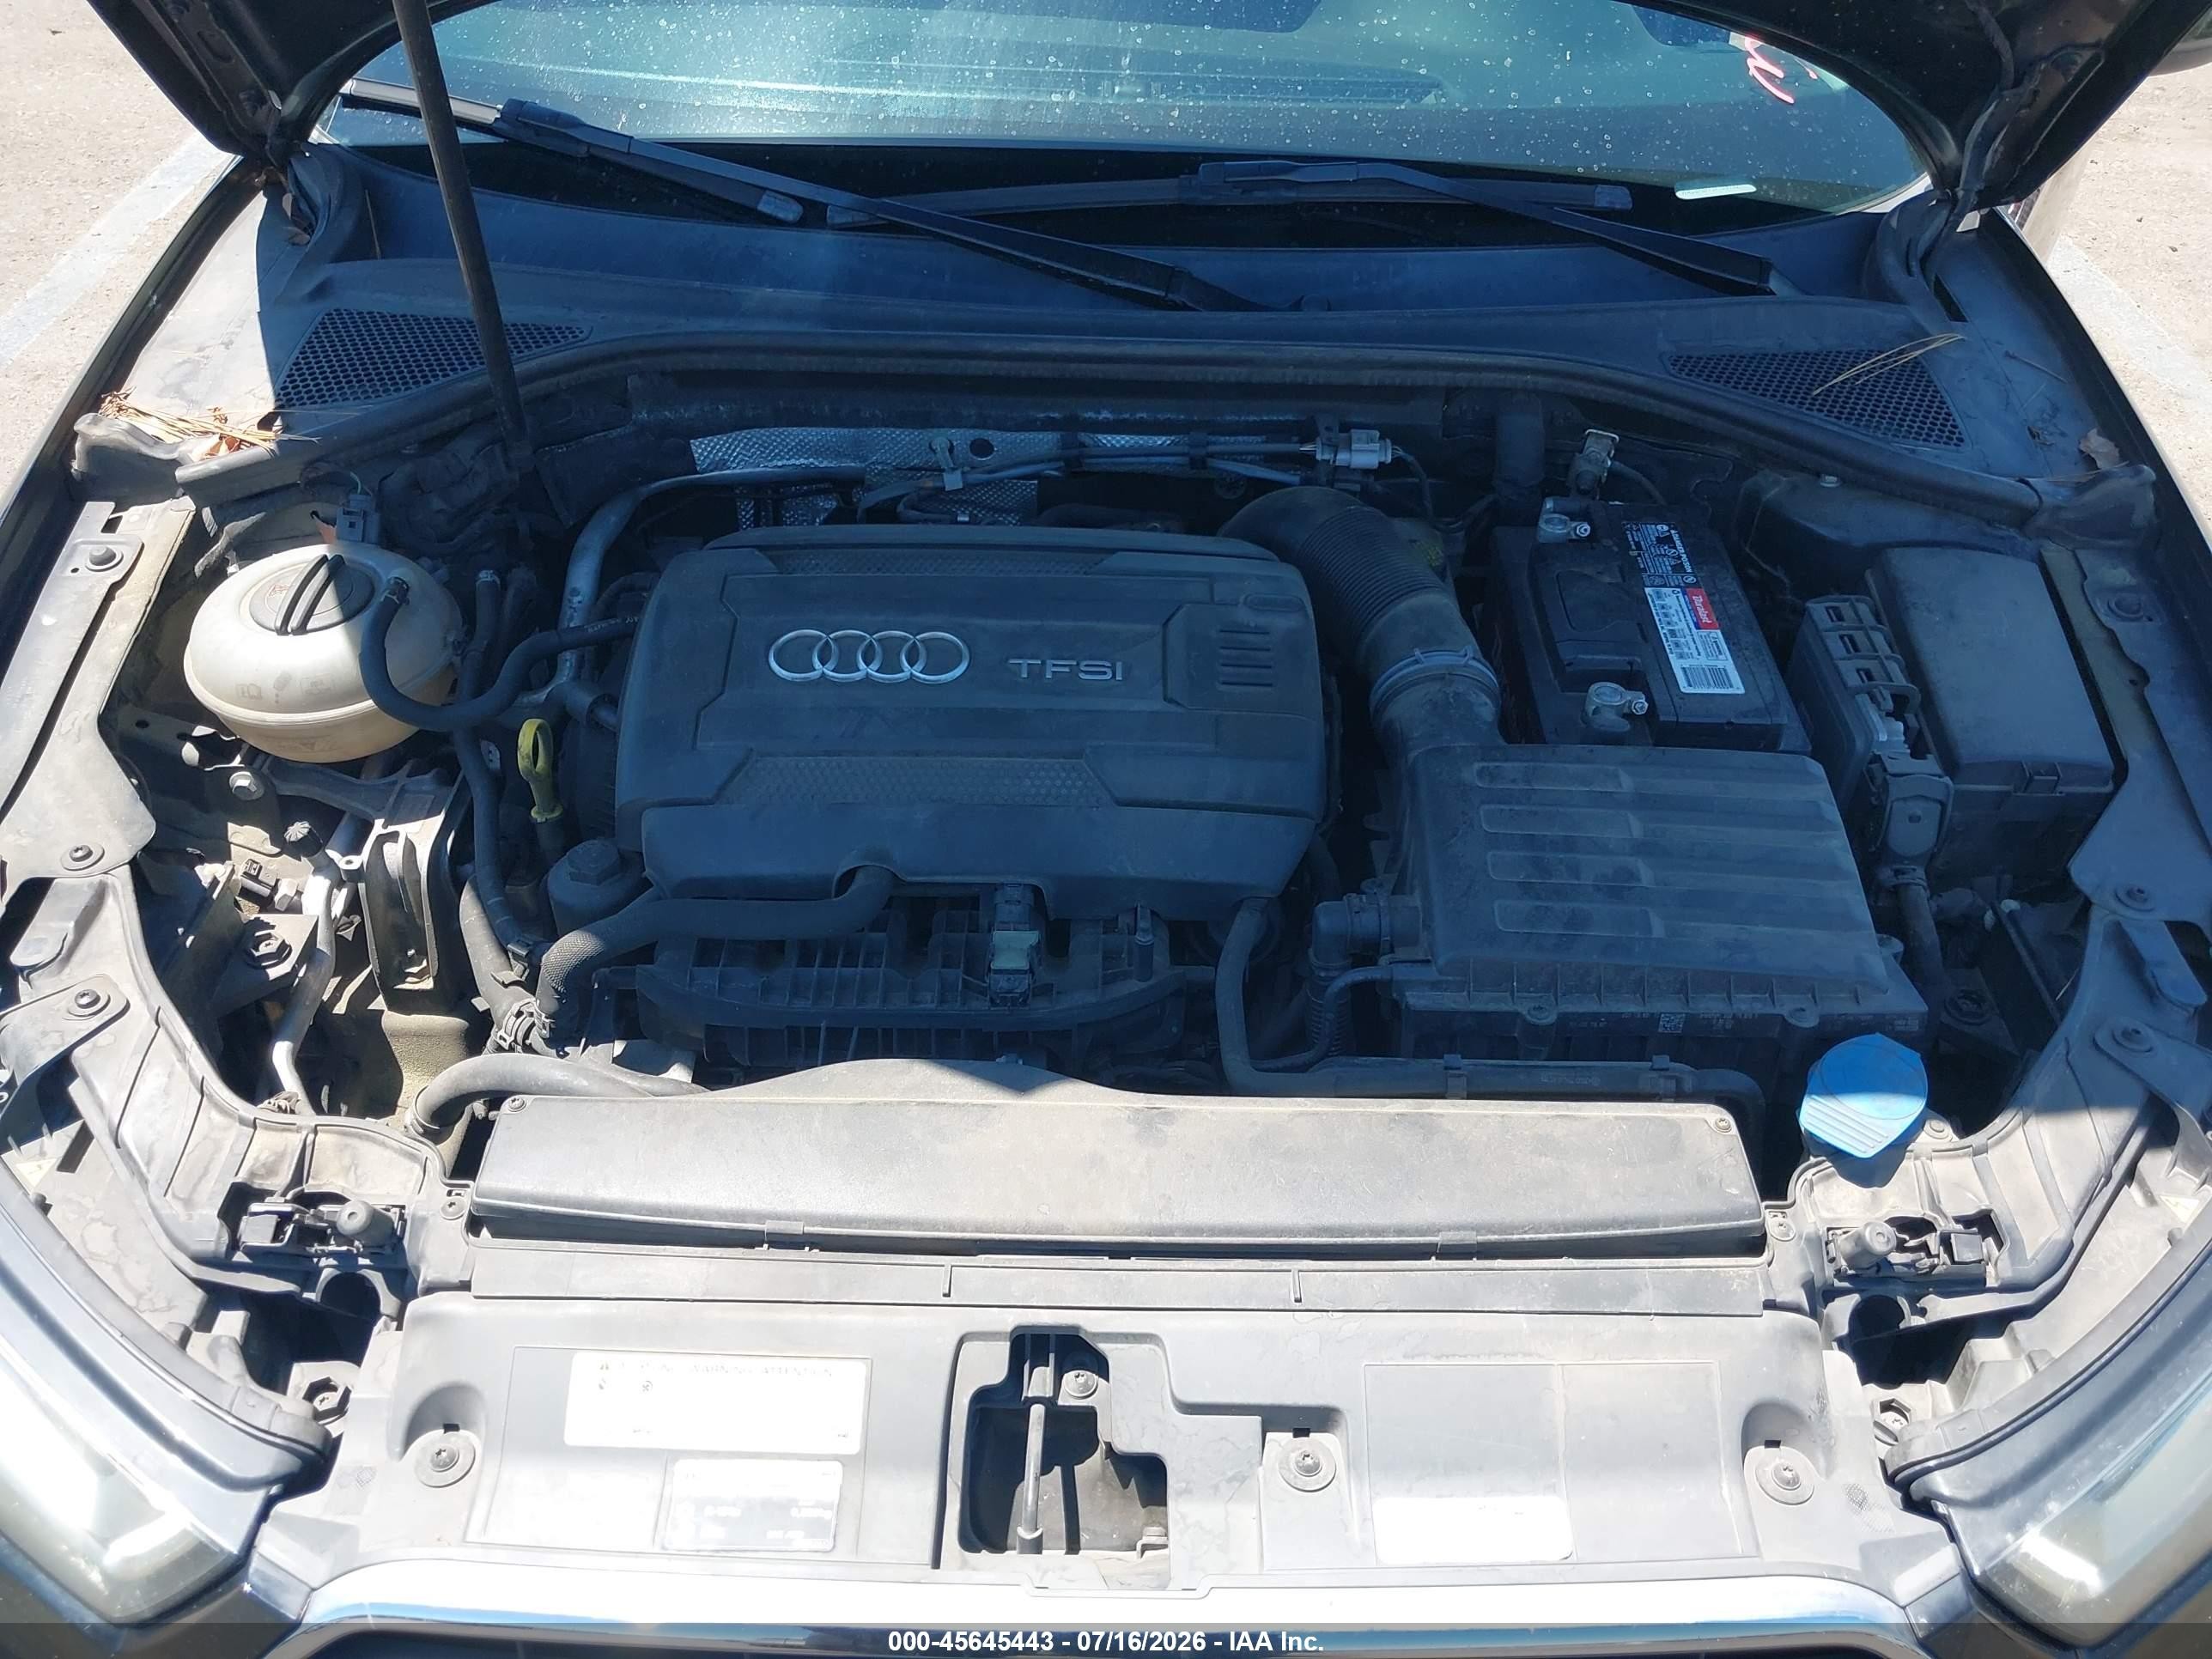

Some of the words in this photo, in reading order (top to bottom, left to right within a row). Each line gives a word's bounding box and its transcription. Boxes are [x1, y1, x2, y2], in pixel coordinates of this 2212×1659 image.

[1680, 553, 1692, 573] POISON
[1692, 594, 1713, 623] Duralast
[1008, 659, 1123, 681] TFSI
